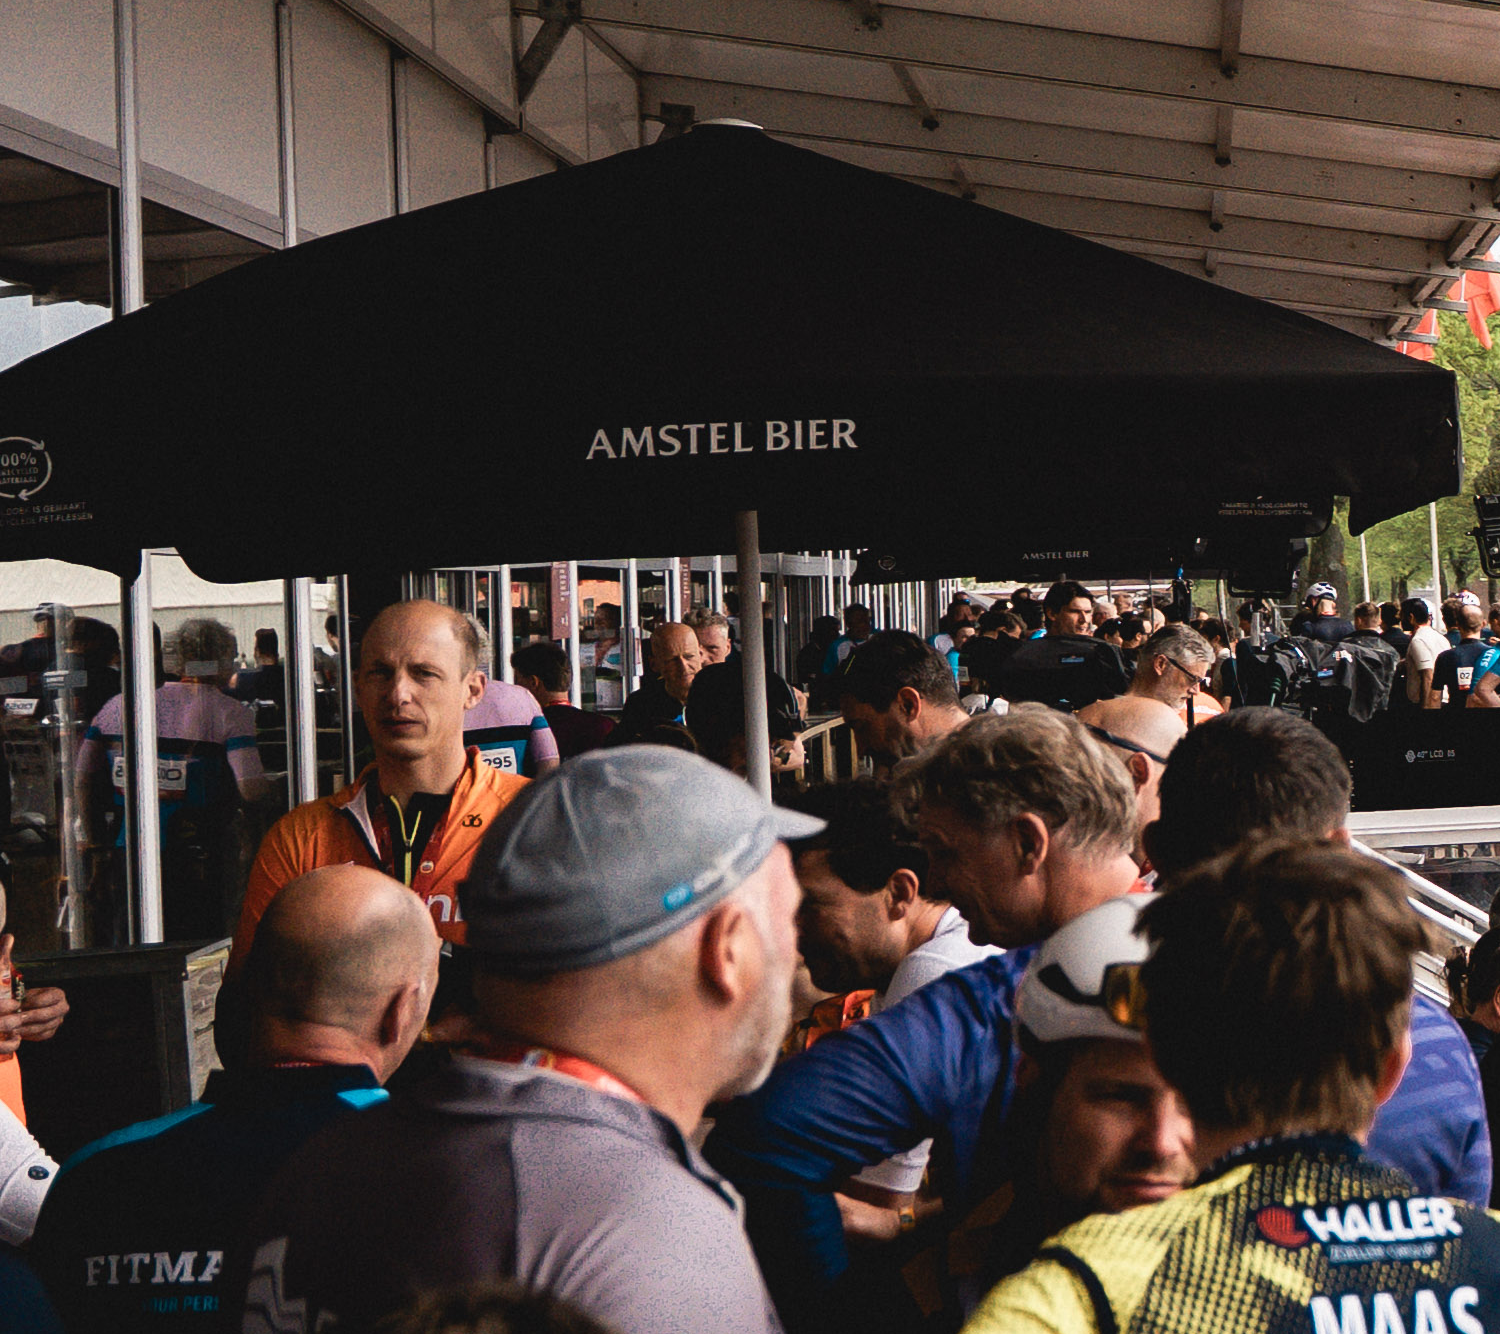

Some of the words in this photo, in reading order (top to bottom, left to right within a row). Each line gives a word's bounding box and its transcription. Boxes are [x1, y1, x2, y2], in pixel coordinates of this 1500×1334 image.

[585, 421, 754, 461] AMSTEL
[765, 418, 860, 453] BIER
[0, 453, 37, 467] 00%
[1022, 552, 1063, 560] AMSTEL
[1065, 550, 1089, 559] BIER
[1302, 1197, 1463, 1242] HALLER
